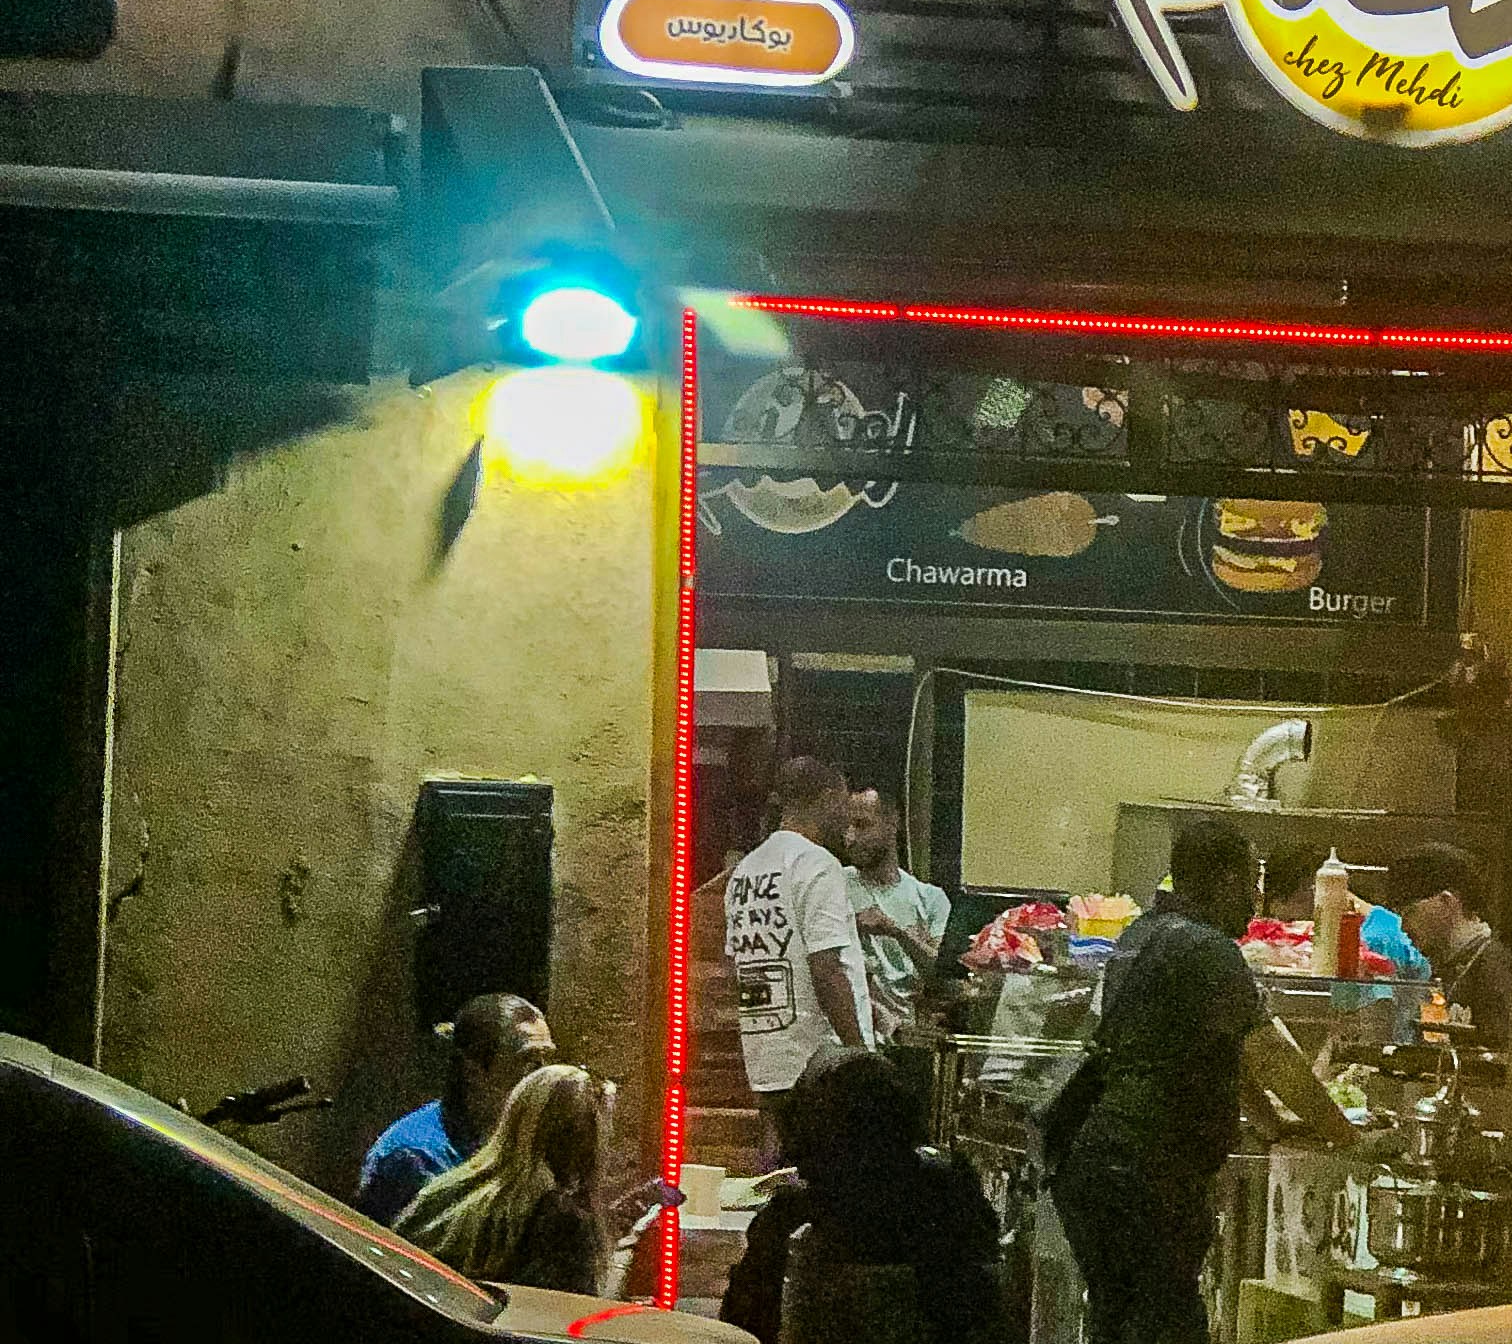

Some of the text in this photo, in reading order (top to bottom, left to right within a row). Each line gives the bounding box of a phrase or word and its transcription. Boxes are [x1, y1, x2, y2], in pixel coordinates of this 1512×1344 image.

[1283, 34, 1464, 109] chez Mehdi
[886, 558, 1027, 588] Chawarma
[1309, 586, 1398, 619] Burger
